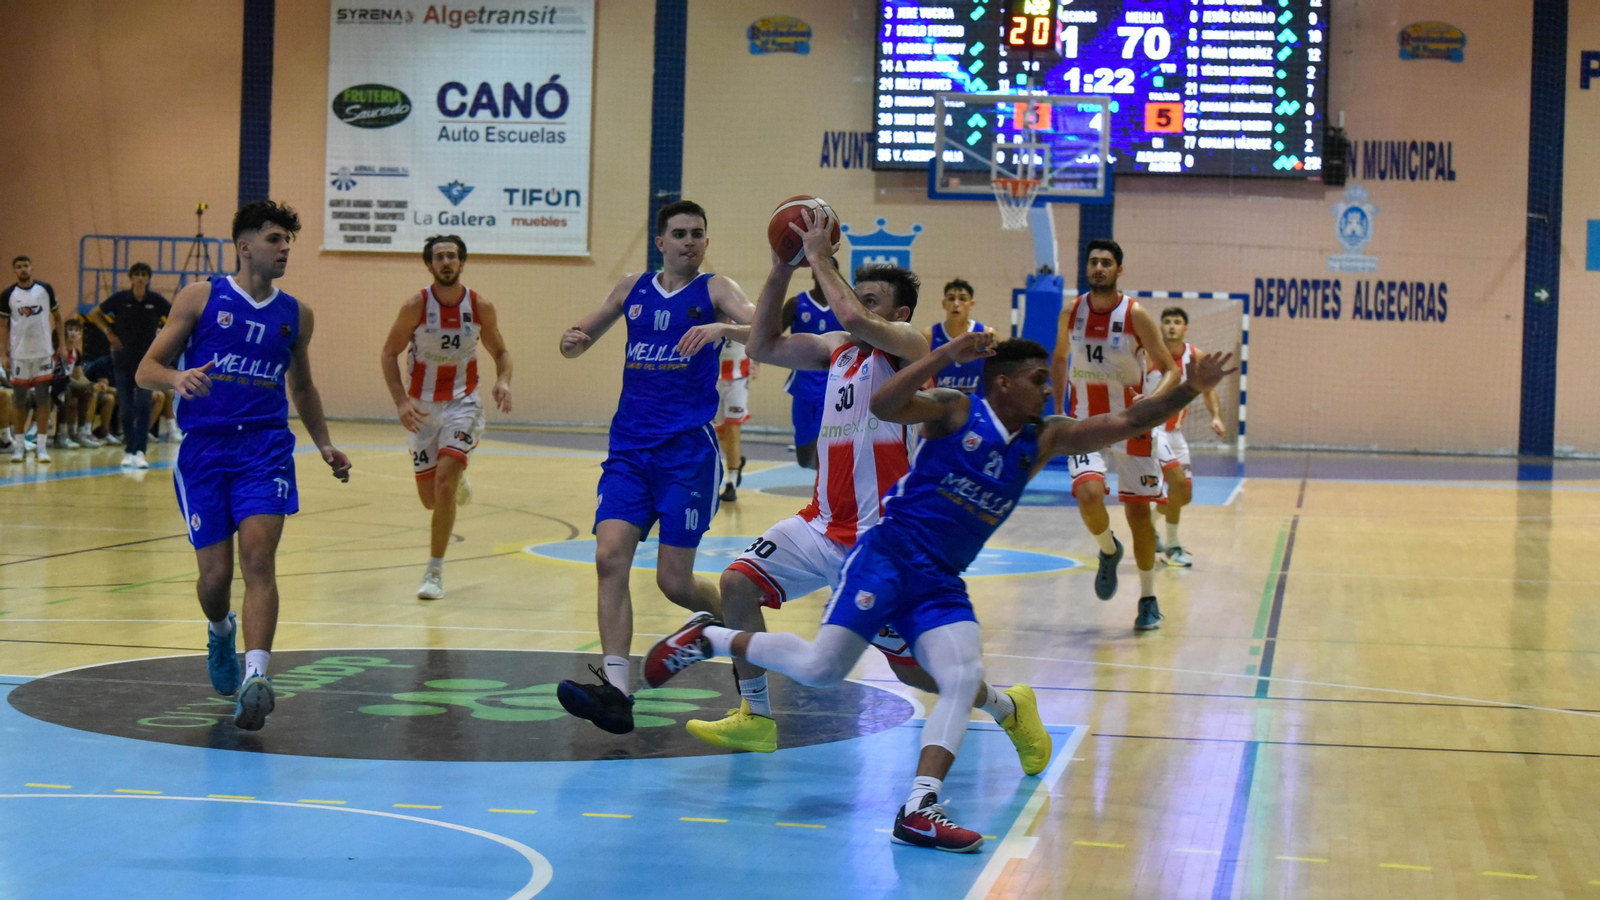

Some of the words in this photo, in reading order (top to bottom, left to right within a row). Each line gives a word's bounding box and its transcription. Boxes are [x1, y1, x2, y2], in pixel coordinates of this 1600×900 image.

[337, 9, 402, 21] SYRENA
[423, 5, 557, 28] Algetransit
[884, 6, 893, 19] 3
[1125, 11, 1164, 24] MELILLA
[1231, 11, 1275, 23] CASTILLO
[884, 24, 892, 36] 7
[1009, 16, 1050, 45] 20
[882, 42, 893, 54] 11
[1117, 26, 1171, 60] 70
[1186, 46, 1199, 59] 10
[1307, 48, 1321, 61] 12
[880, 59, 894, 72] 14
[1186, 64, 1197, 77] 11
[1307, 66, 1316, 79] 2
[879, 77, 893, 90] 24
[1063, 67, 1135, 93] 1:22
[436, 74, 569, 119] CANÓ
[1185, 82, 1197, 95] 21
[1307, 84, 1314, 97] 7
[343, 102, 410, 122] Saucedo
[1184, 100, 1198, 113] 22
[997, 114, 1005, 128] 7
[1156, 108, 1172, 127] 5
[438, 126, 479, 143] Auto
[485, 126, 566, 143] Escuelas
[1305, 120, 1312, 134] 1
[1183, 136, 1196, 149] 77
[1304, 138, 1314, 152] 2
[1363, 140, 1456, 181] MUNICIPAL
[413, 210, 433, 226] La
[438, 211, 496, 226] Galera
[511, 215, 568, 227] muebles
[1254, 277, 1342, 320] DEPORTES
[1352, 280, 1448, 323] ALGECIRAS
[653, 309, 671, 331] 10
[245, 319, 265, 344] 77
[441, 334, 460, 349] 24
[1085, 344, 1104, 363] 14
[213, 352, 283, 381] MELILLA
[937, 375, 980, 389] MELILLA
[835, 383, 854, 412] 30
[413, 449, 429, 466] 24
[983, 450, 1004, 479] 21
[1072, 454, 1090, 468] 14
[273, 477, 289, 499] 77
[940, 472, 1013, 517] MELILLA
[685, 508, 699, 530] 10
[743, 536, 777, 559] 30
